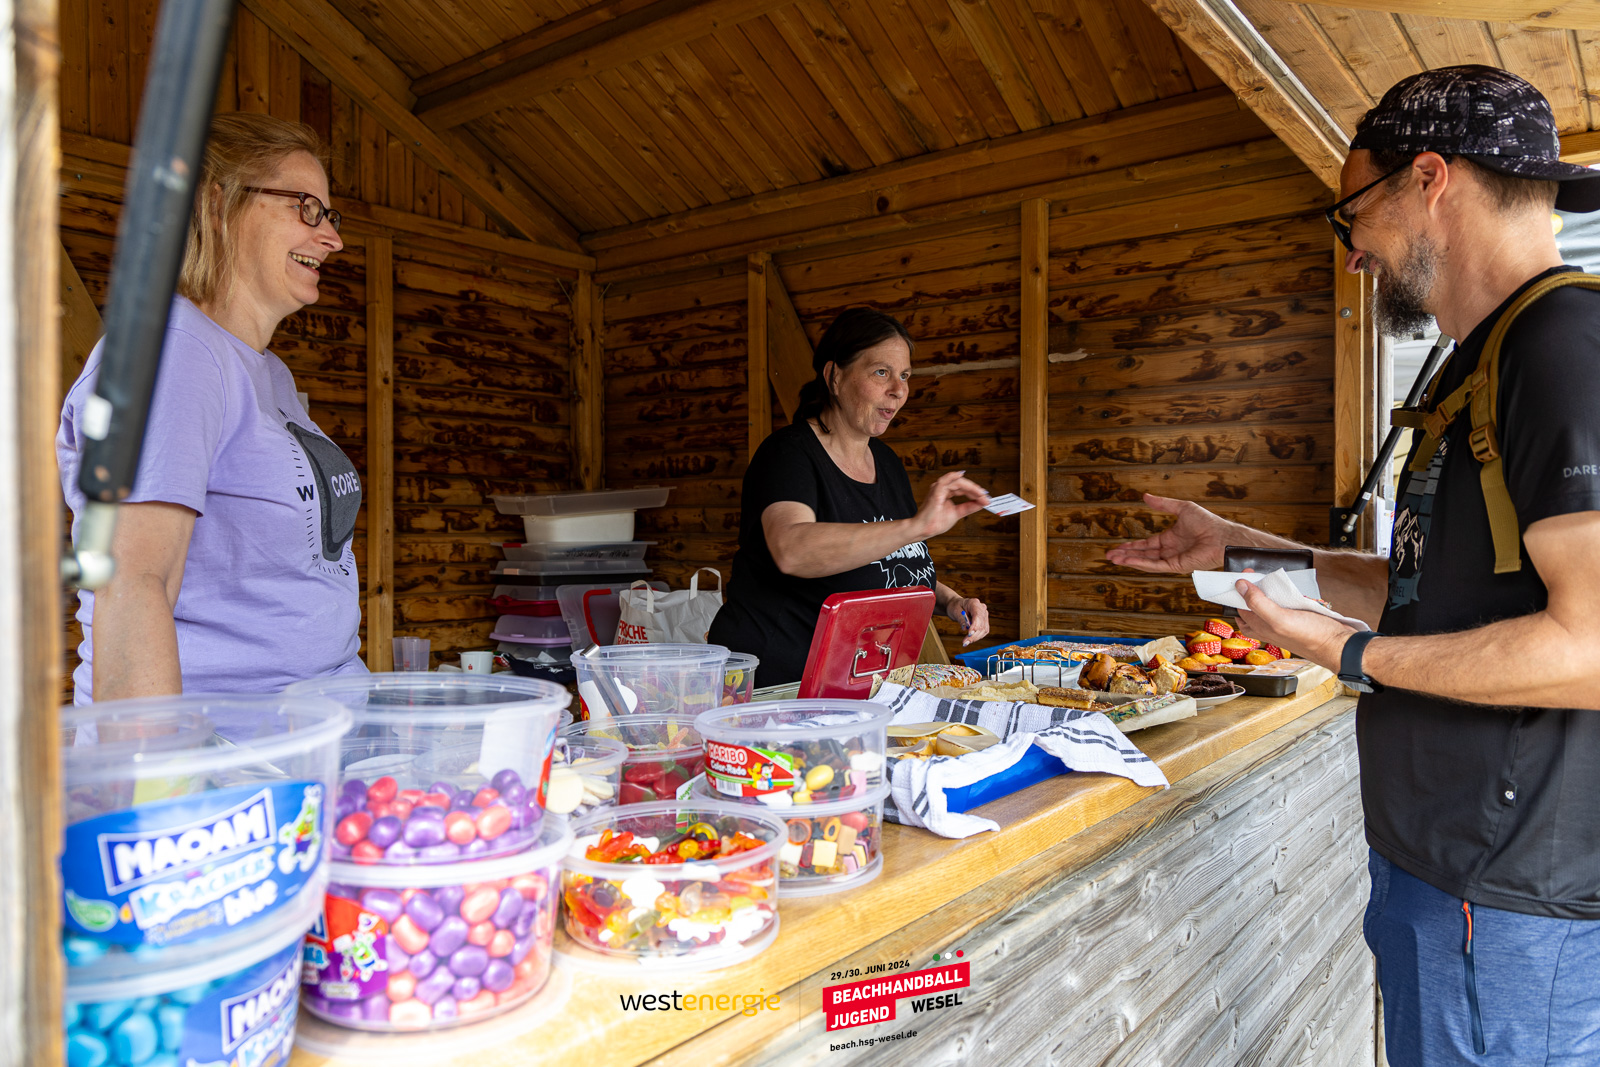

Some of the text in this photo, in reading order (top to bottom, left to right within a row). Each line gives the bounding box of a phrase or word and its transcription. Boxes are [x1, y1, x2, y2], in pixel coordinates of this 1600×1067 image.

[1563, 464, 1600, 478] DARE
[296, 484, 314, 502] W
[331, 471, 359, 498] CORE
[707, 742, 747, 766] HARIBO
[711, 760, 747, 776] Color-Rado
[113, 803, 268, 883] MAOAM
